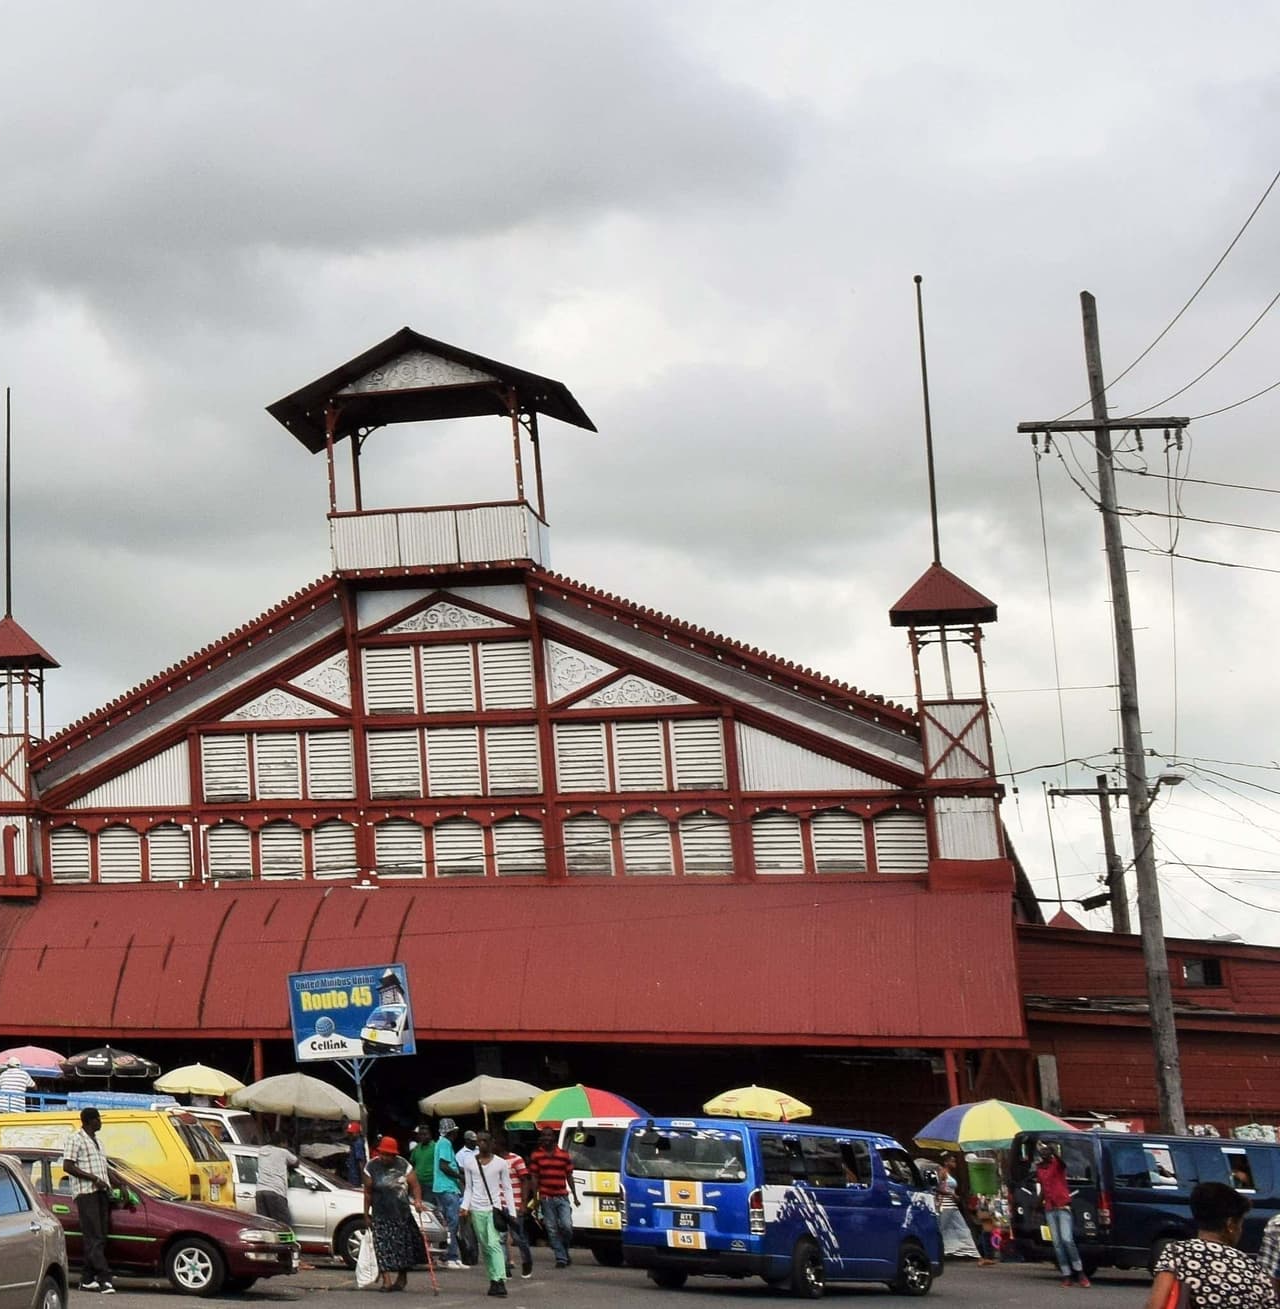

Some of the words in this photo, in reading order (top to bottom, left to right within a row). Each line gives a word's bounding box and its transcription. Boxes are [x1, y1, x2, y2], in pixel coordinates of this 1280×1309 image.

[301, 990, 349, 1012] Route
[351, 986, 373, 1007] 45
[310, 1039, 348, 1051] Cellink
[680, 1235, 693, 1244] 45
